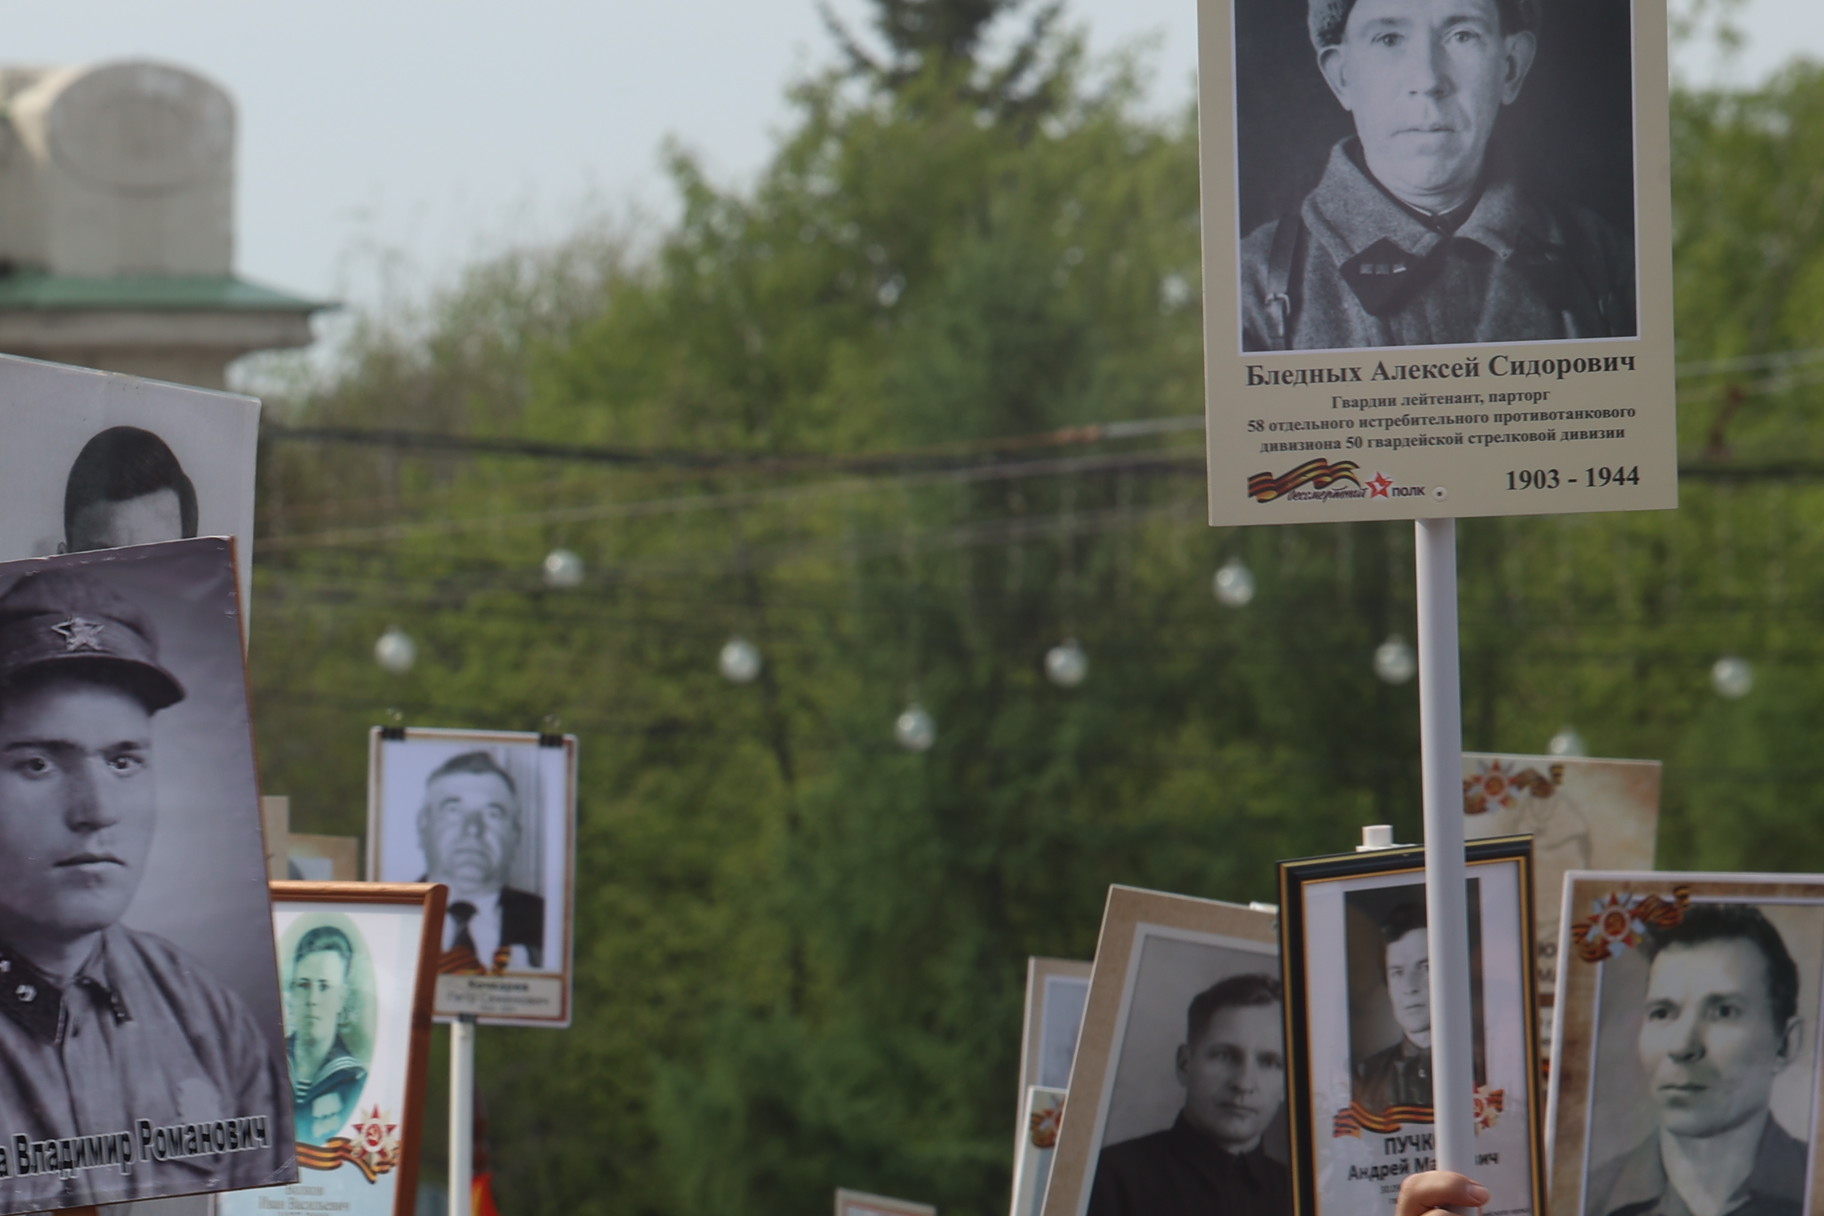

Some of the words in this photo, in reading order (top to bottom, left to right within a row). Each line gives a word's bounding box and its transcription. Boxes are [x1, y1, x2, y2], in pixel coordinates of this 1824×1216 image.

[1246, 364, 1363, 387] Бледных
[1371, 356, 1480, 382] Алексей
[1488, 354, 1636, 380] Сидорович
[1332, 395, 1397, 411] Гвардии
[1488, 390, 1551, 406] парторг
[1247, 419, 1265, 433] 58
[1268, 418, 1355, 432] отдельного
[1359, 412, 1489, 430] истребительного
[1493, 407, 1636, 426] противотанкового
[1260, 439, 1342, 454] дивизиона
[1345, 435, 1363, 449] 50
[1367, 432, 1464, 450] гвардейской
[1467, 428, 1557, 446] стрелковой
[1559, 427, 1626, 441] дивизии
[1506, 468, 1560, 490] 1903
[1584, 465, 1640, 488] 1944
[12, 1130, 136, 1179] Владимир
[135, 1114, 272, 1163] Романович
[1347, 1158, 1409, 1181] Андрей
